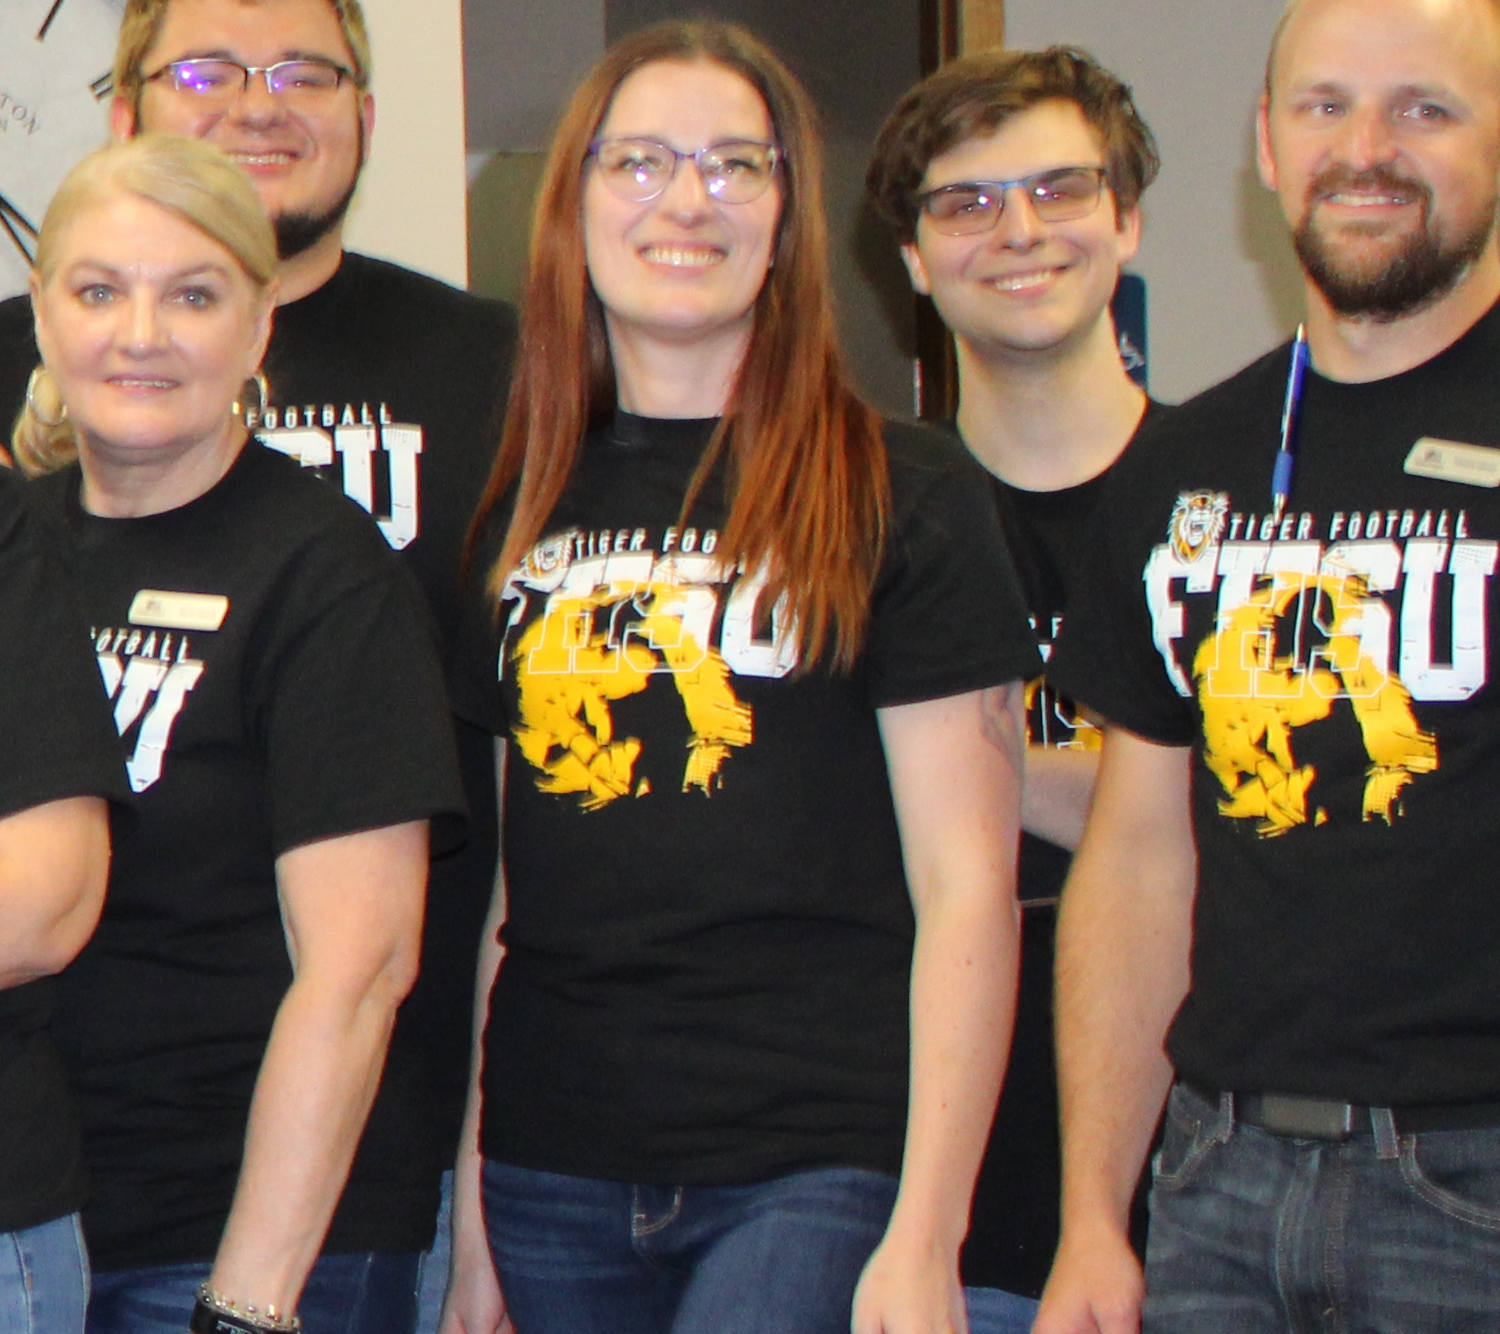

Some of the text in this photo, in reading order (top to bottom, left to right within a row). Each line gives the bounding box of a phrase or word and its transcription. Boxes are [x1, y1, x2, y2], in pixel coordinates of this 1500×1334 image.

[246, 402, 392, 430] FOOTBALL
[1230, 509, 1473, 542] TIGER FOOTBALL
[575, 528, 647, 560] TIGER
